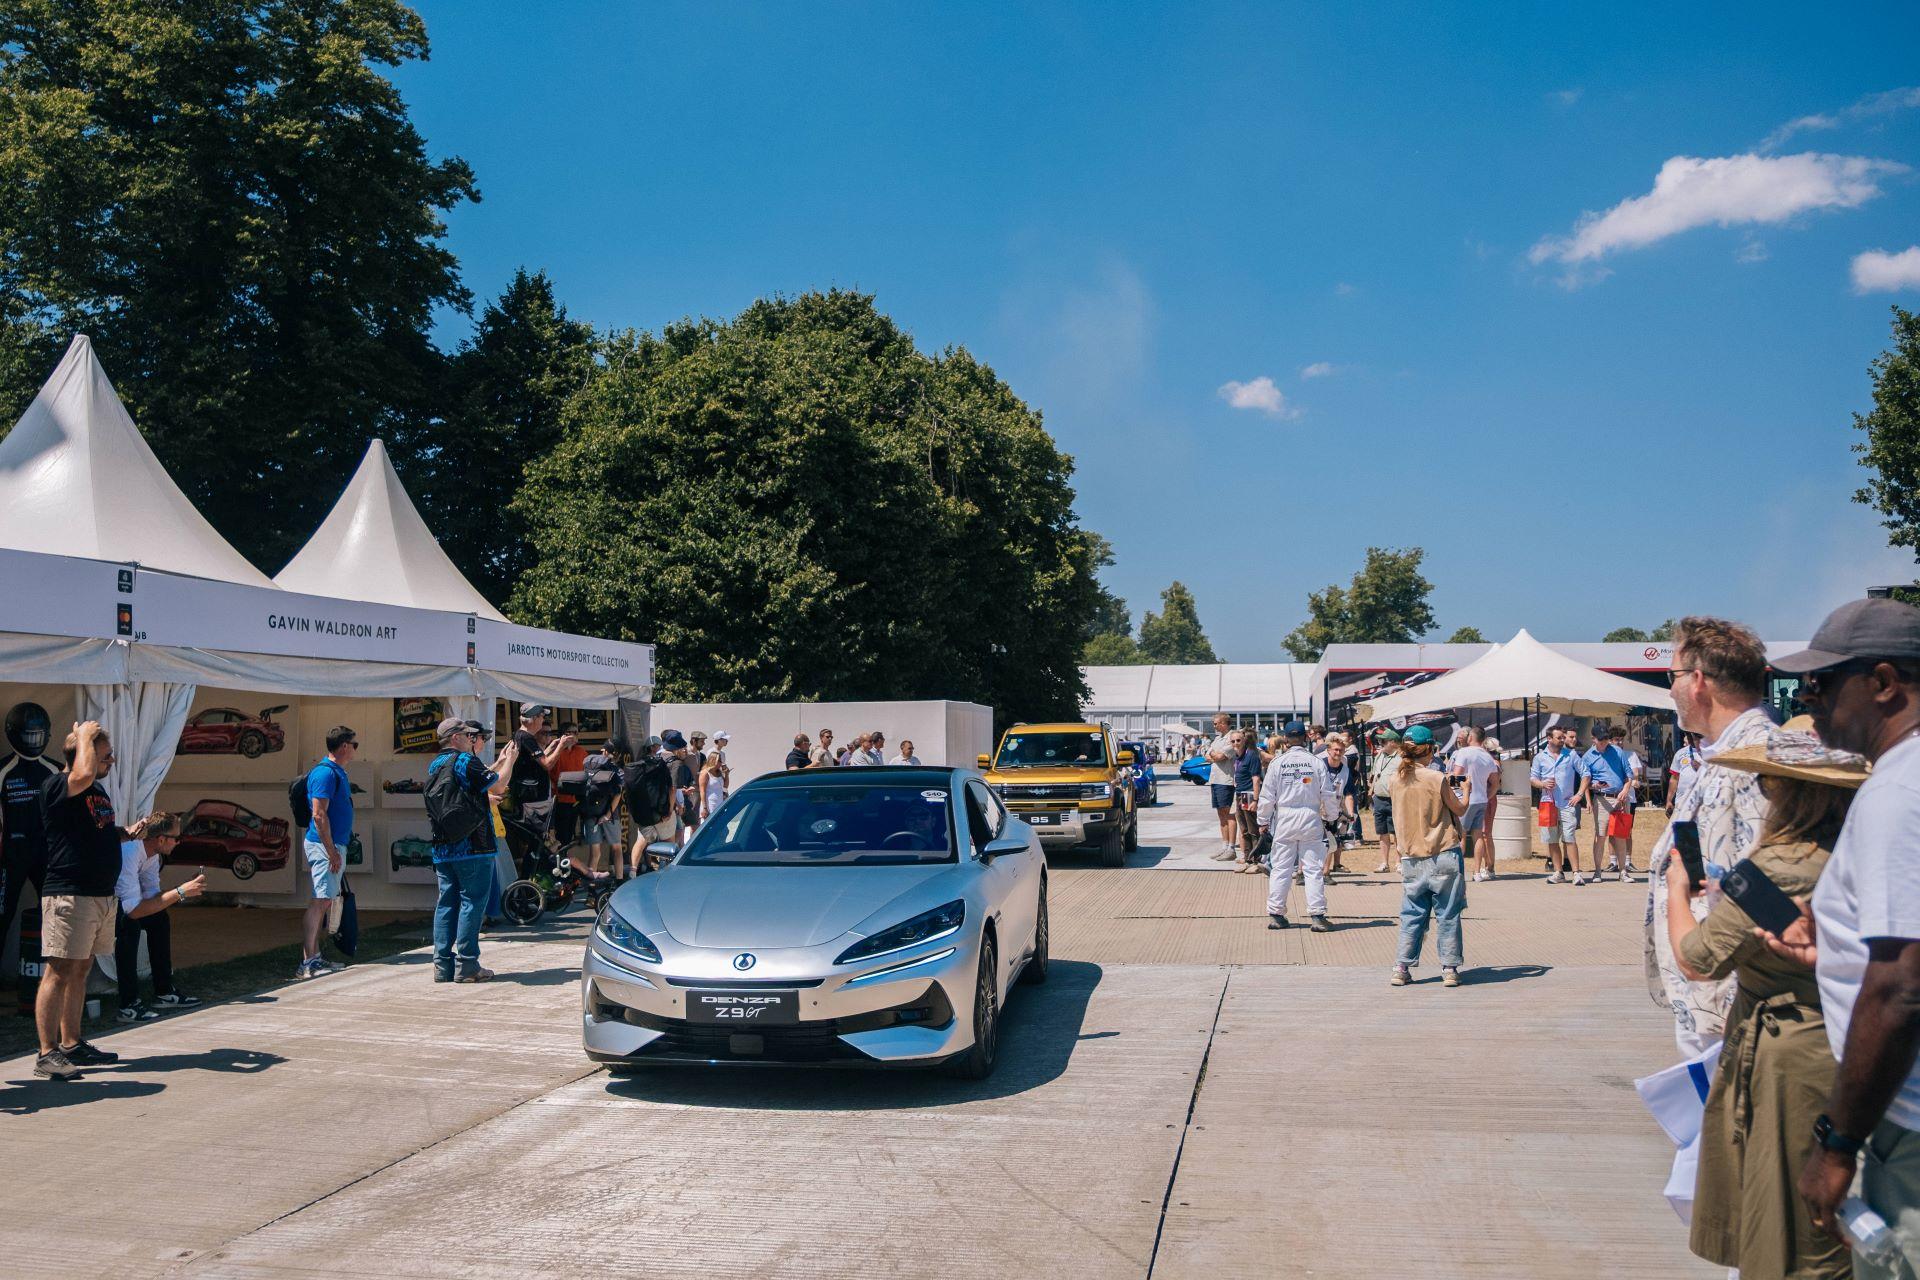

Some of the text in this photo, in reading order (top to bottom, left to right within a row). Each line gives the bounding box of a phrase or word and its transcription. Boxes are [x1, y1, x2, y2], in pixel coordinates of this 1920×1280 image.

[268, 614, 398, 640] GAVIN WALDRON ART
[508, 642, 630, 669] JARROTTS MOTORSPORT COLLECTION
[701, 996, 781, 1004] DENZA
